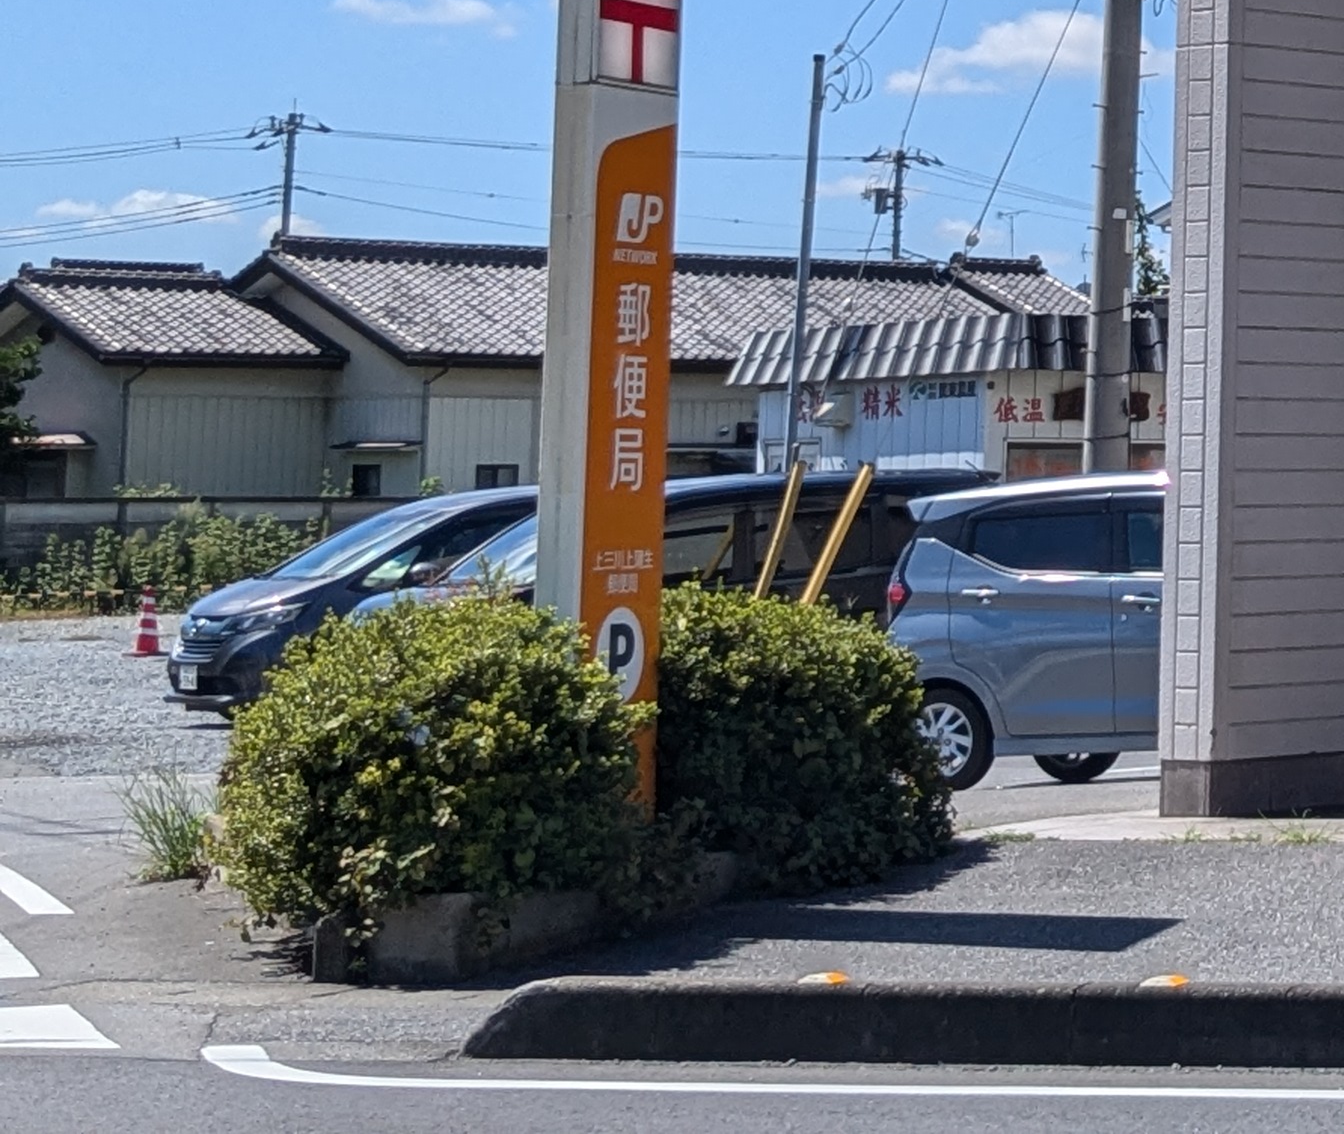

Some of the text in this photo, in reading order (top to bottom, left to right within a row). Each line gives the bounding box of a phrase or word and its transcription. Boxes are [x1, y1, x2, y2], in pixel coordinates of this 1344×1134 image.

[616, 193, 663, 243] JP
[613, 248, 658, 265] NETWORK
[610, 282, 650, 491] 郵便局
[861, 383, 904, 420] 精米
[994, 397, 1045, 423] 低温
[609, 623, 635, 677] P
